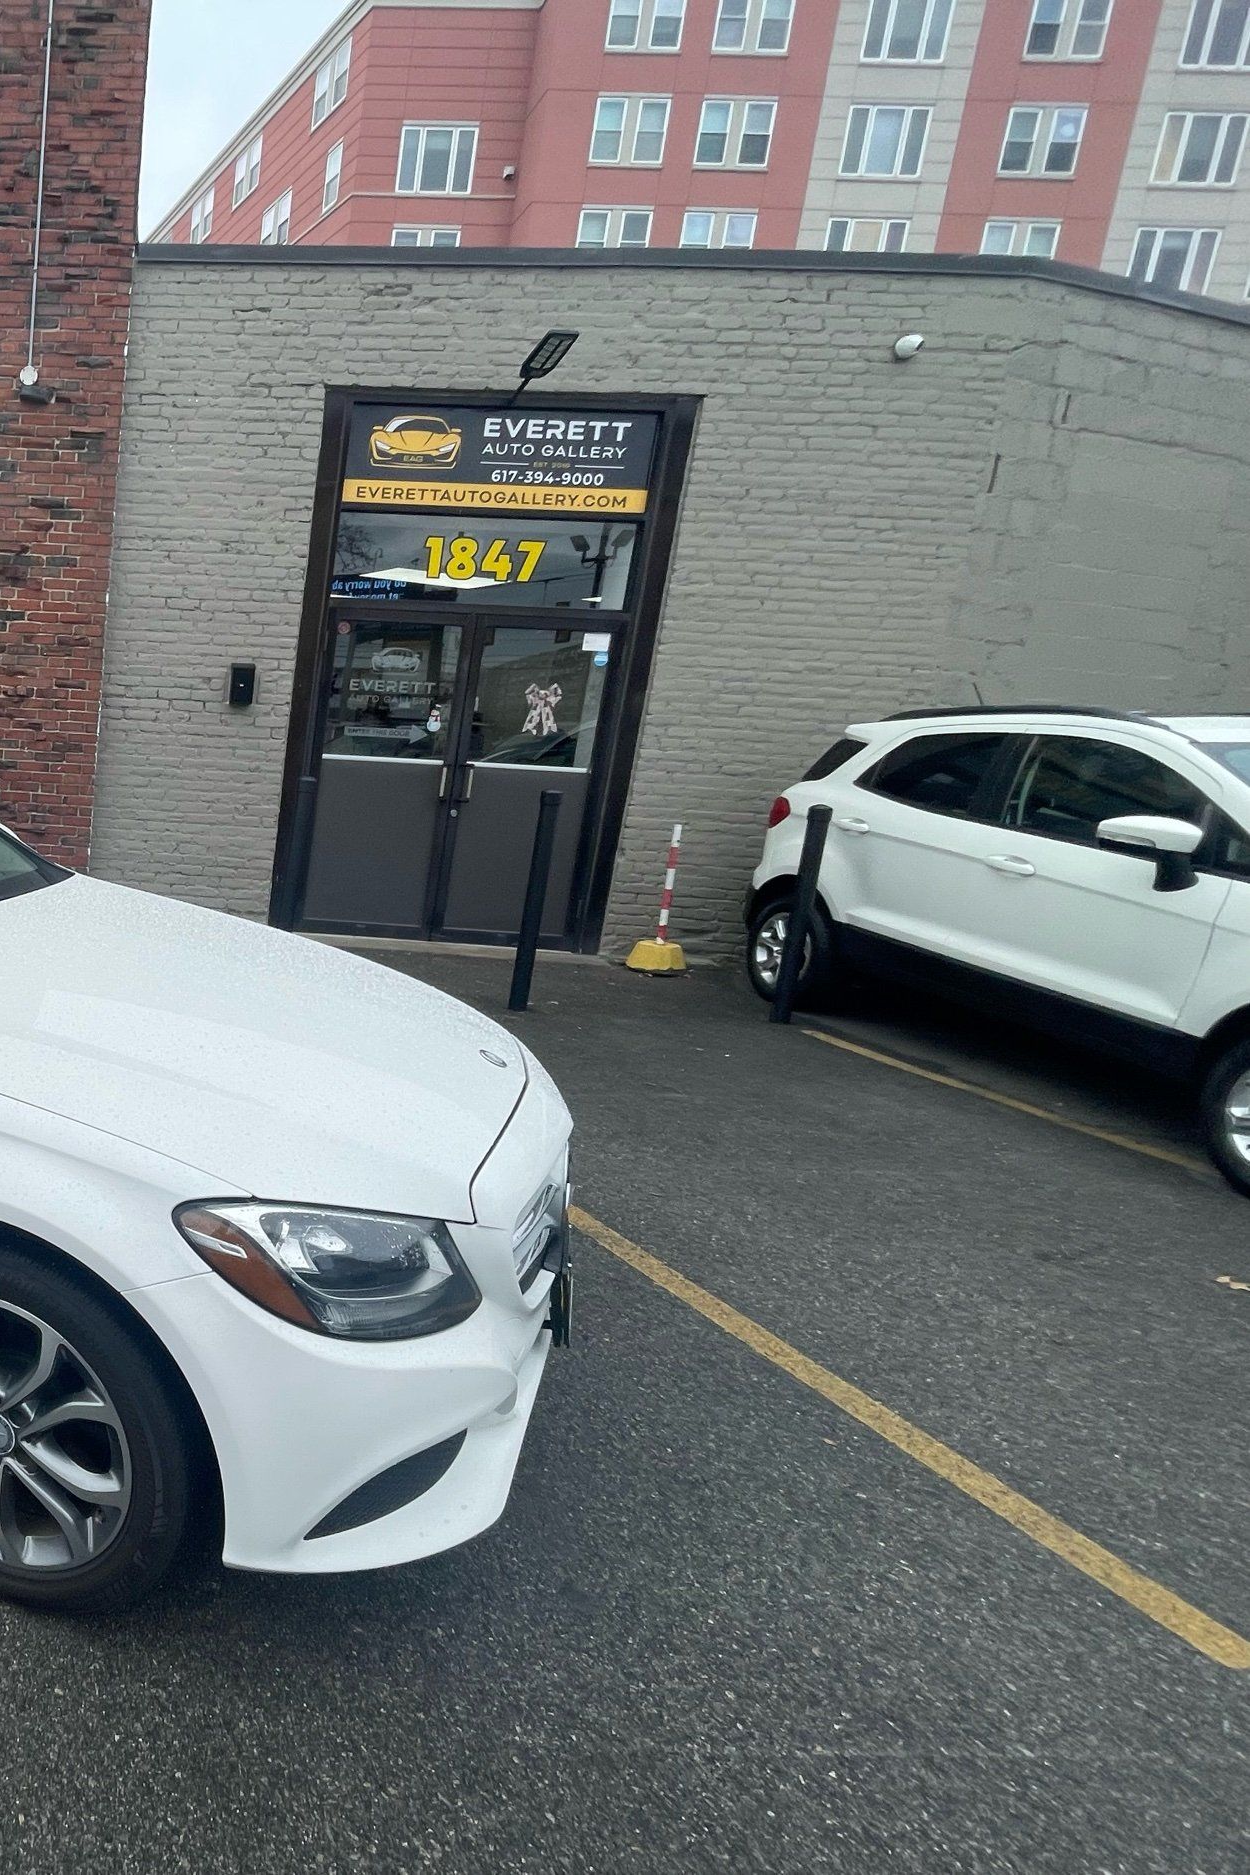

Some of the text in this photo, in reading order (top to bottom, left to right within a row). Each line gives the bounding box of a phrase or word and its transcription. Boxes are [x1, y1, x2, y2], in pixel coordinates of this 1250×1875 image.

[483, 417, 633, 442] EVERETT
[403, 455, 424, 463] EAG
[481, 443, 628, 459] AUTO GALLERY
[491, 470, 604, 486] 617-394-9000
[356, 486, 628, 508] EVERETTAUTOGALLERY.COM
[424, 535, 546, 583] 1847
[349, 678, 437, 694] EVERETT
